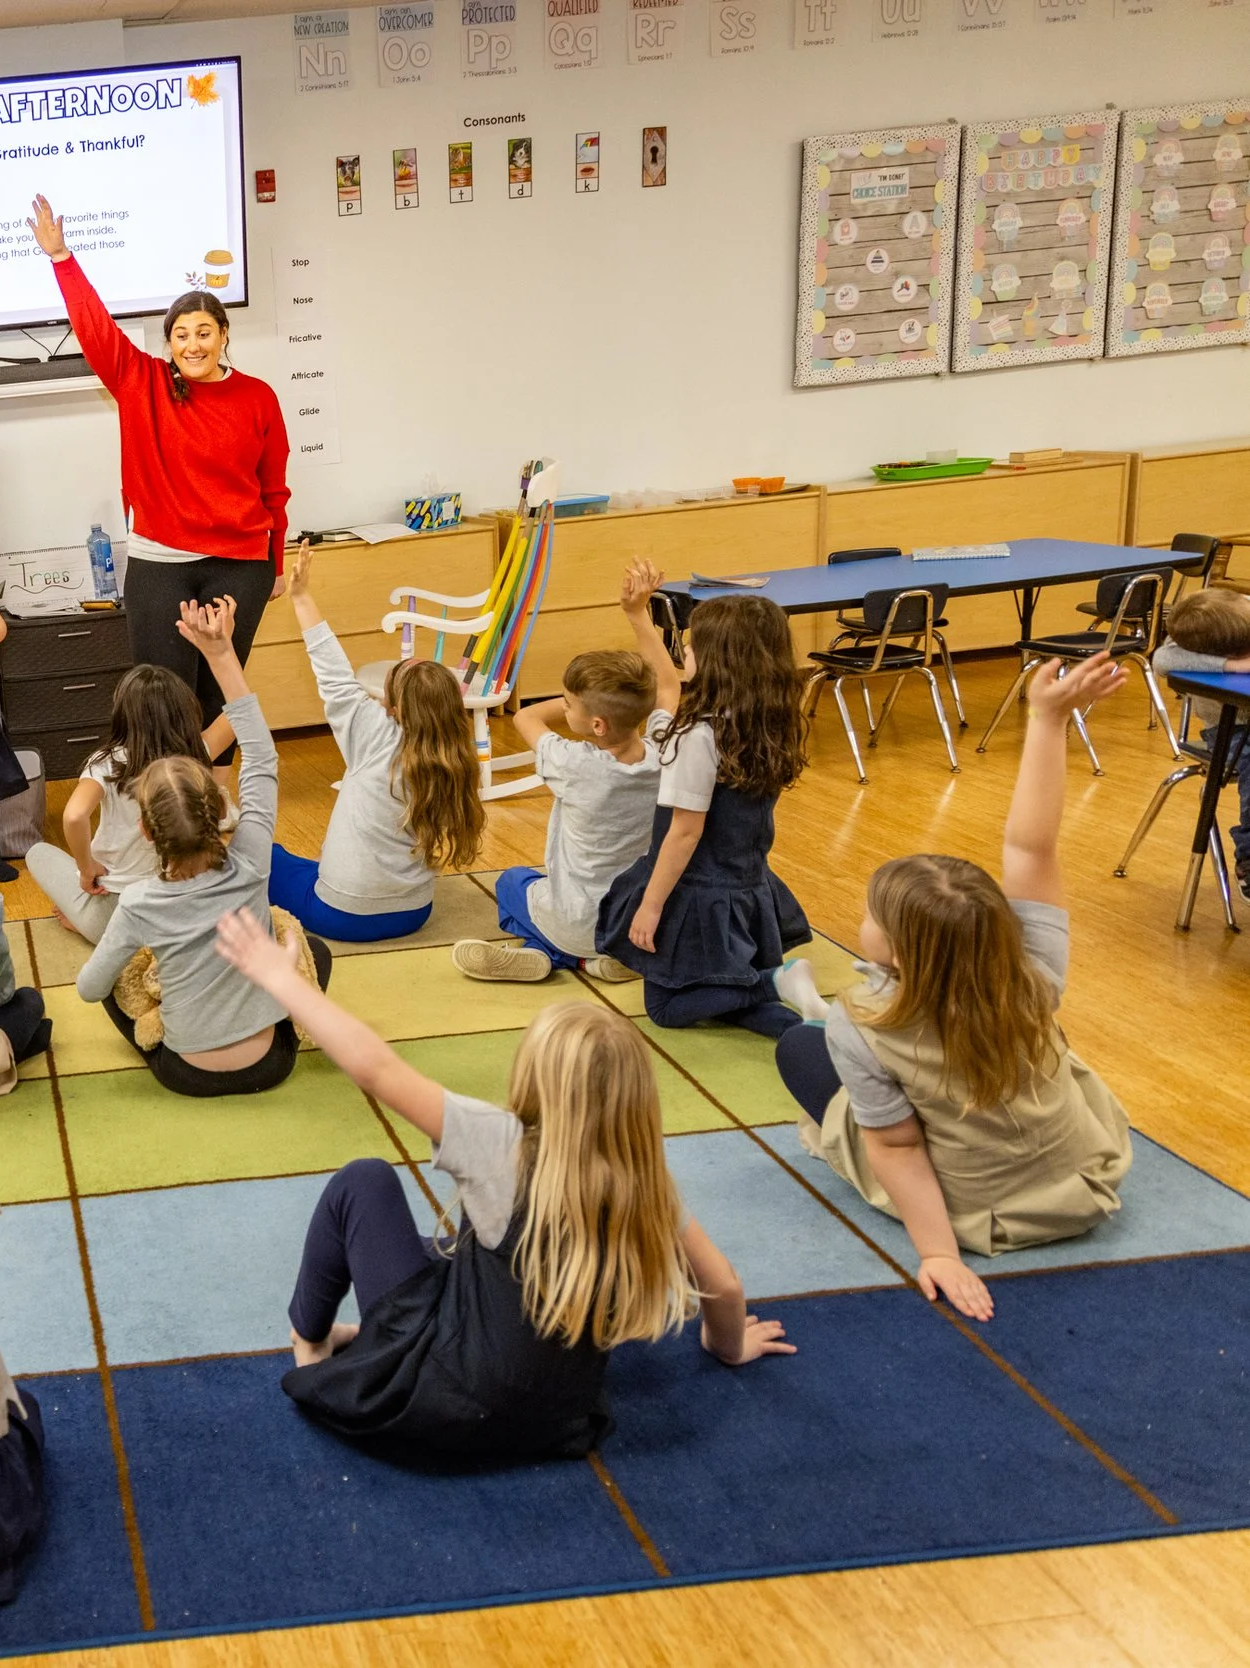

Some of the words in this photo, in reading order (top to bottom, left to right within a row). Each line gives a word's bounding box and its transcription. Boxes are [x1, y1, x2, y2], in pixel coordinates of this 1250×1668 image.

[379, 11, 434, 32] OVERCOMER
[461, 4, 515, 25] PROTECTED
[719, 5, 757, 41] Ss
[293, 24, 312, 37] NEW
[313, 19, 349, 35] CREATION
[634, 12, 677, 49] Rr
[466, 28, 512, 70] Pp
[549, 21, 599, 61] Qq
[299, 42, 347, 79] Nn
[382, 36, 431, 71] Oo
[463, 112, 526, 128] Consonants
[64, 142, 75, 155] &
[79, 134, 146, 154] Thankful?
[1005, 147, 1077, 167] HAPPY
[584, 179, 591, 191] k
[986, 165, 1103, 189] BIRTHDAY
[458, 189, 465, 201] t
[517, 184, 524, 197] d
[878, 183, 908, 197] STATION
[346, 202, 354, 213] p
[403, 195, 411, 207] b
[12, 219, 23, 229] of
[101, 209, 130, 221] things
[15, 234, 34, 246] you
[63, 230, 85, 239] arm
[86, 226, 117, 236] inside.
[11, 246, 31, 258] that
[67, 241, 97, 253] eated
[99, 239, 125, 250] those
[291, 258, 310, 268] Stop
[292, 297, 314, 305] Nose
[288, 333, 323, 344] Fricative
[290, 370, 325, 381] Affricate
[299, 407, 321, 417] Glide
[300, 442, 325, 453] Liquid
[8, 560, 71, 588] Trees
